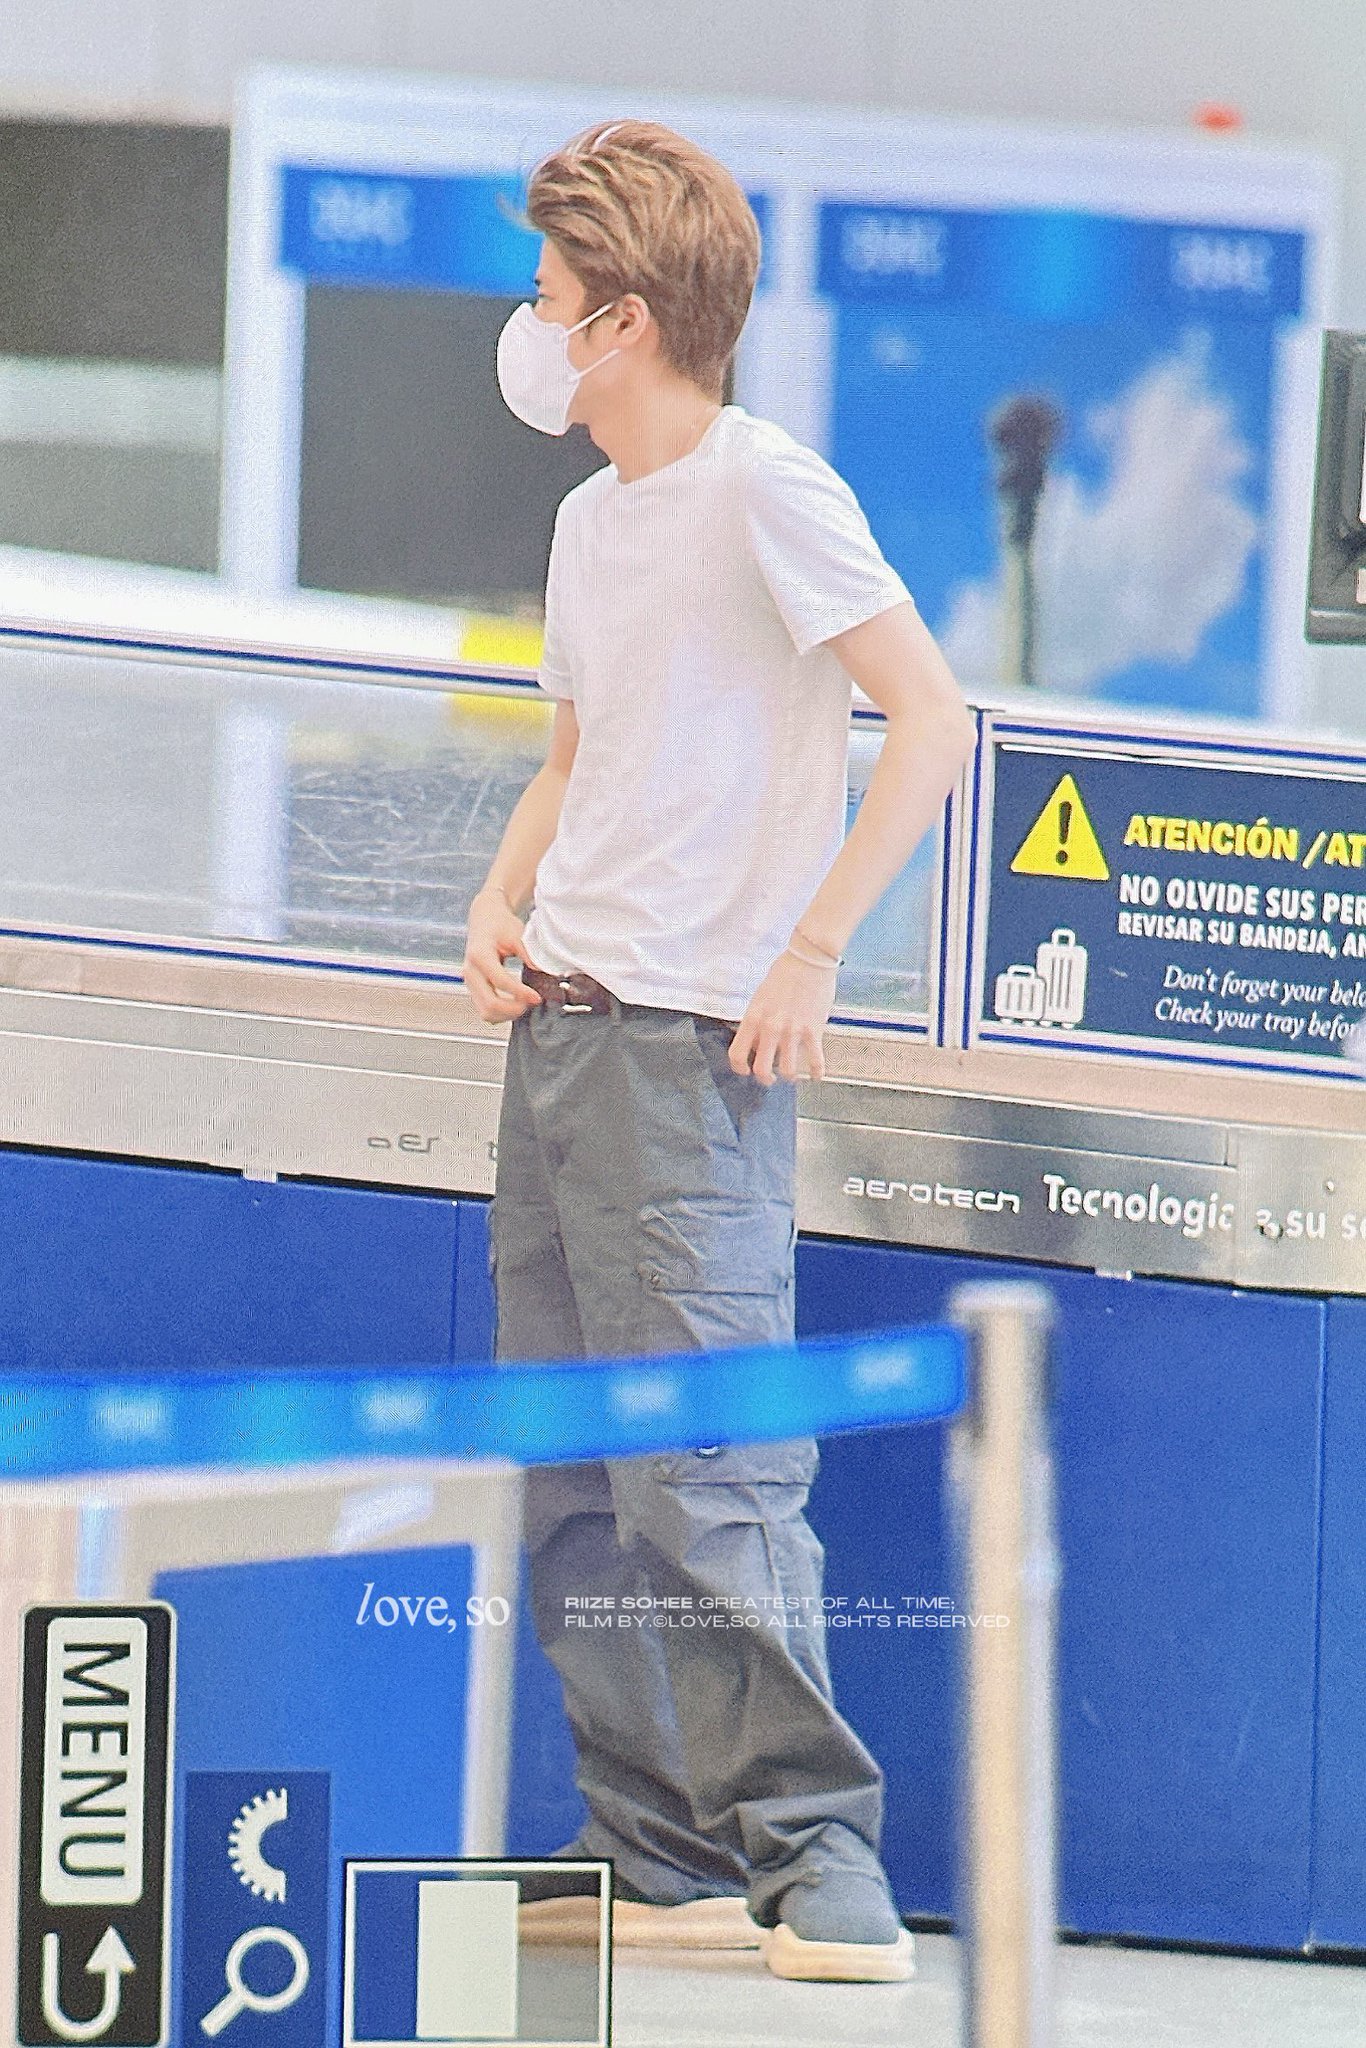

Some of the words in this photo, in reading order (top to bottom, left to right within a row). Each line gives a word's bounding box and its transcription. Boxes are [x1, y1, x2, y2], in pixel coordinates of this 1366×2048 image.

[1122, 814, 1299, 862] ATENCIÓN
[1118, 873, 1160, 906] NO
[1165, 877, 1260, 916] OLVIDE
[1265, 886, 1316, 922] SUS
[1117, 911, 1204, 942] REVISAR
[1207, 919, 1235, 945] SU
[1239, 922, 1336, 959] BANDEJA,
[1162, 964, 1220, 993] Don't
[1220, 970, 1280, 1004] forget
[1280, 981, 1328, 1006] your
[1154, 996, 1213, 1026] Check
[1213, 1009, 1262, 1034] your
[1263, 1011, 1306, 1040] tray
[1286, 1208, 1327, 1239] su
[59, 1642, 132, 1877] MENU
